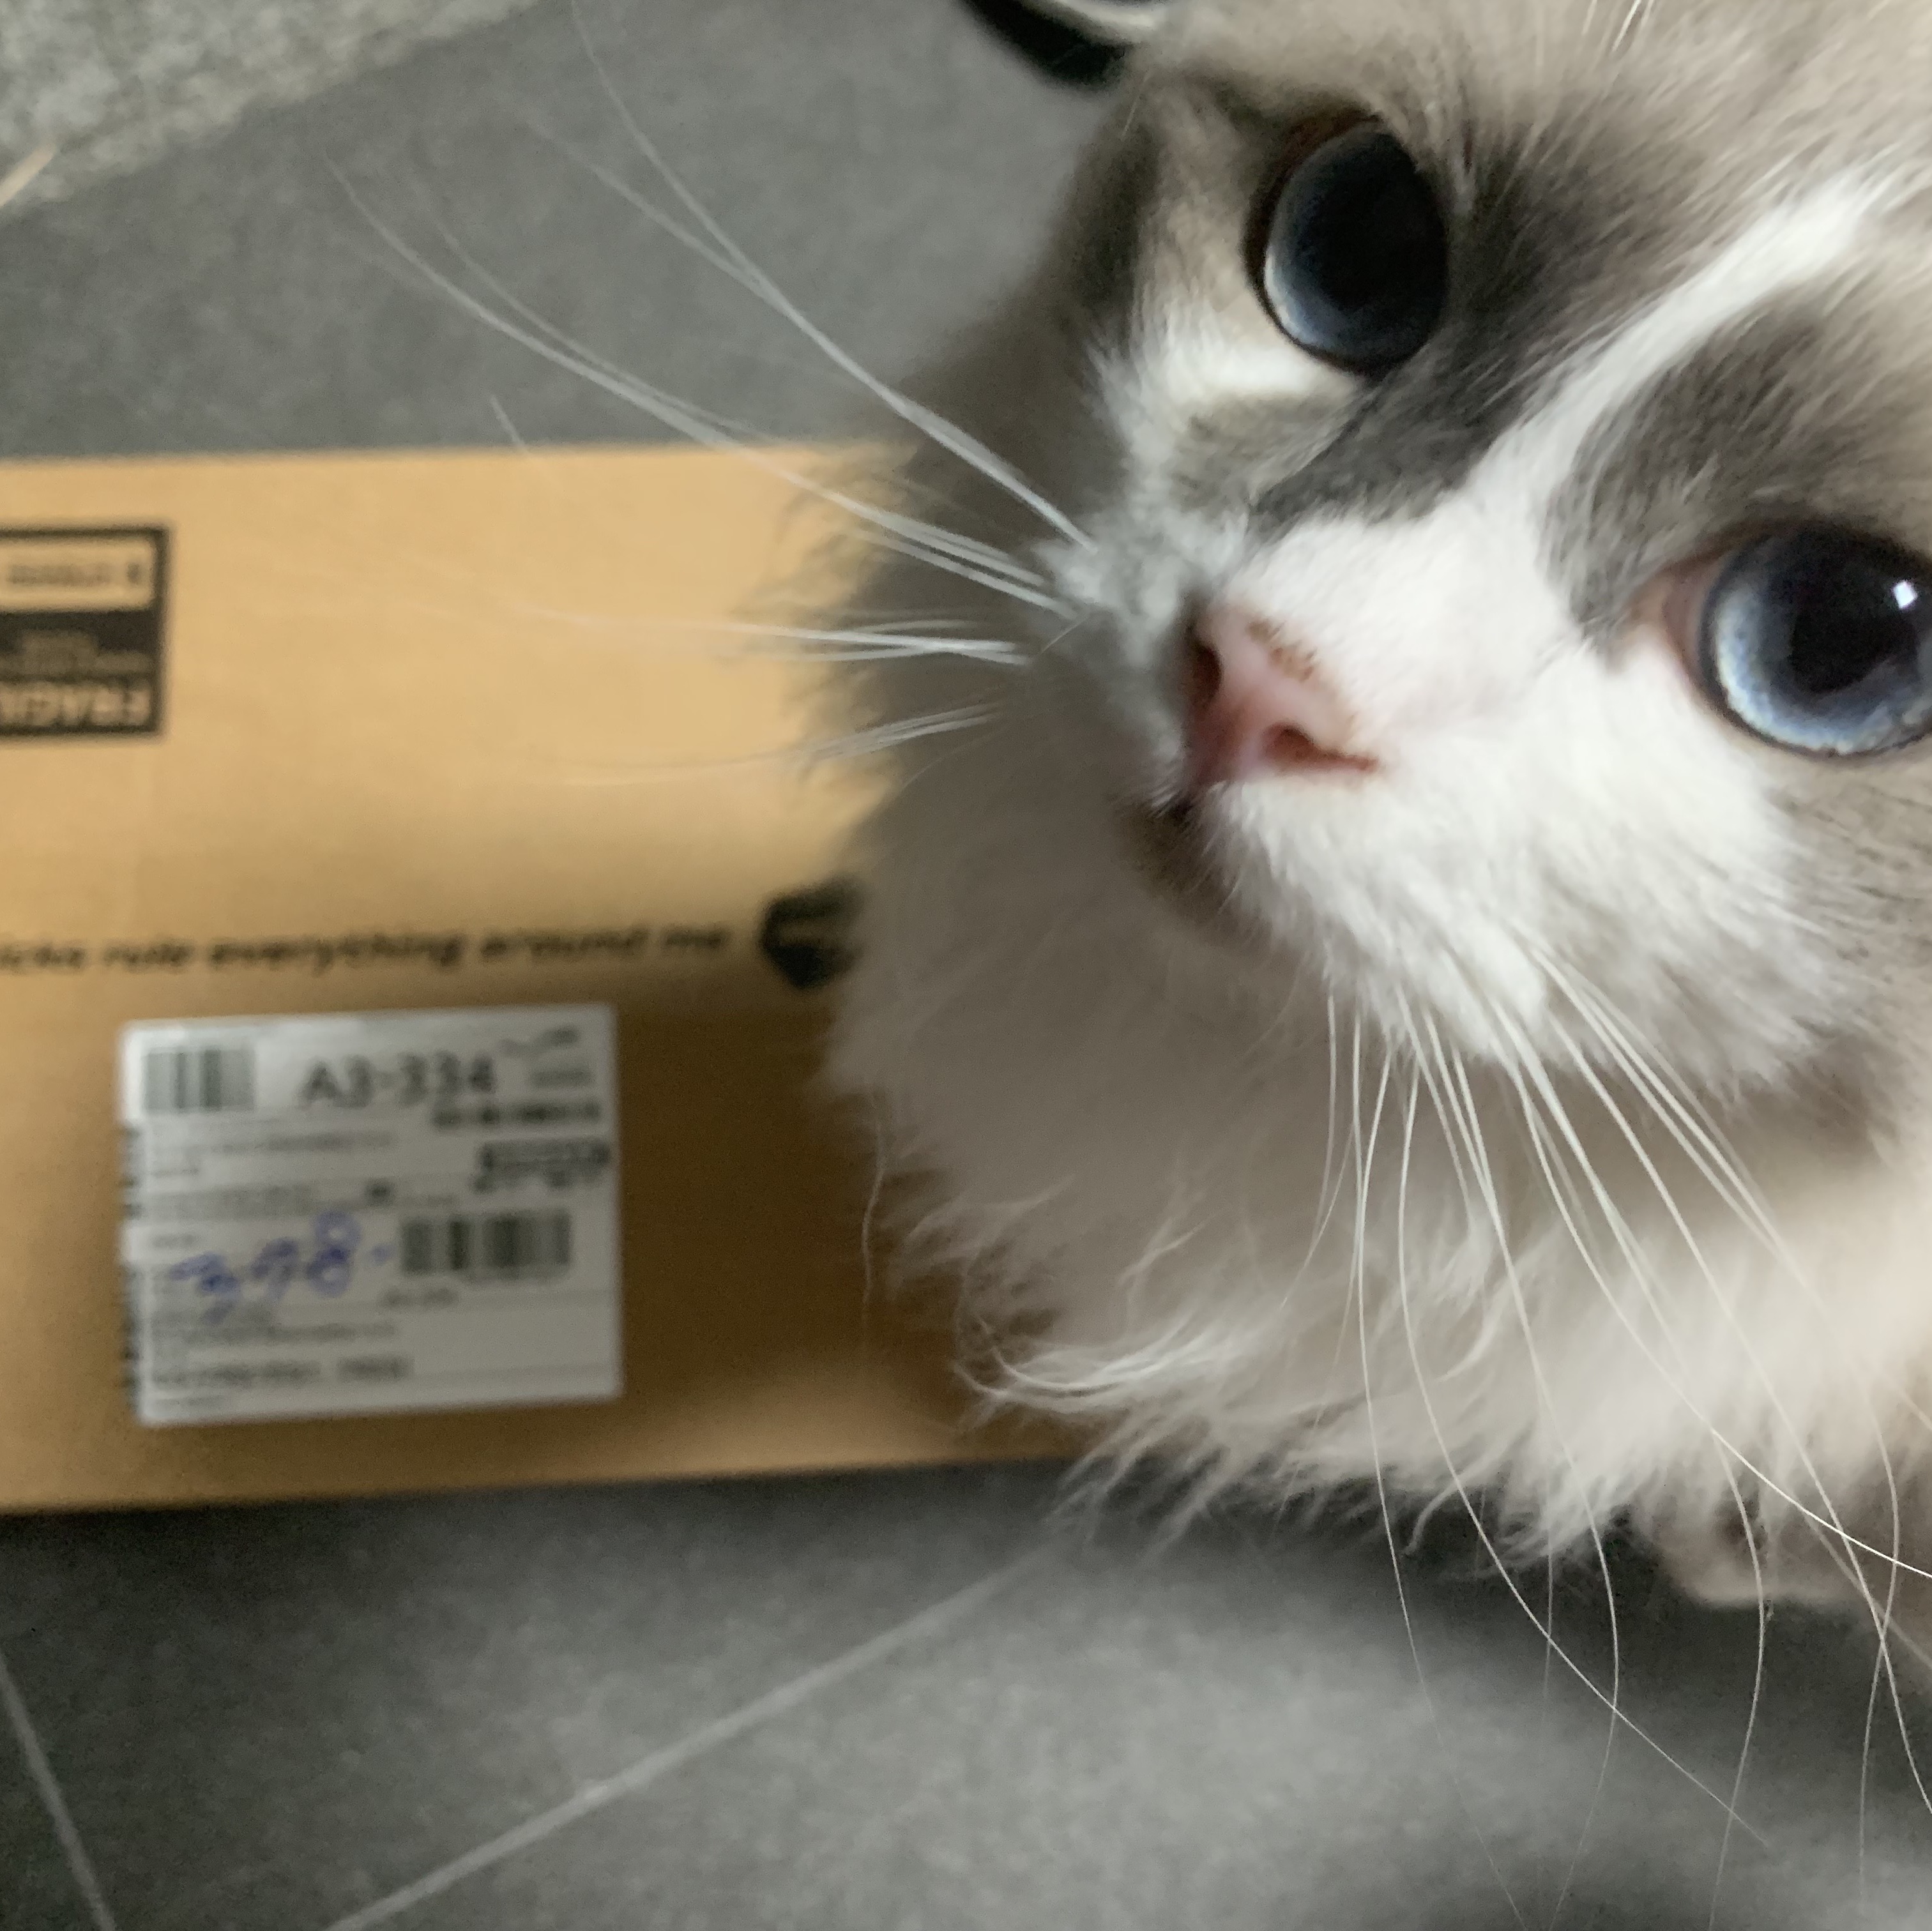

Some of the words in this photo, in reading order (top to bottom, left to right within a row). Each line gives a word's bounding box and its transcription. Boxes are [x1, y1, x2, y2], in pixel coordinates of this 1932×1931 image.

[102, 935, 193, 972] rule
[208, 927, 466, 977] everything
[480, 924, 649, 962] around
[662, 923, 730, 954] me
